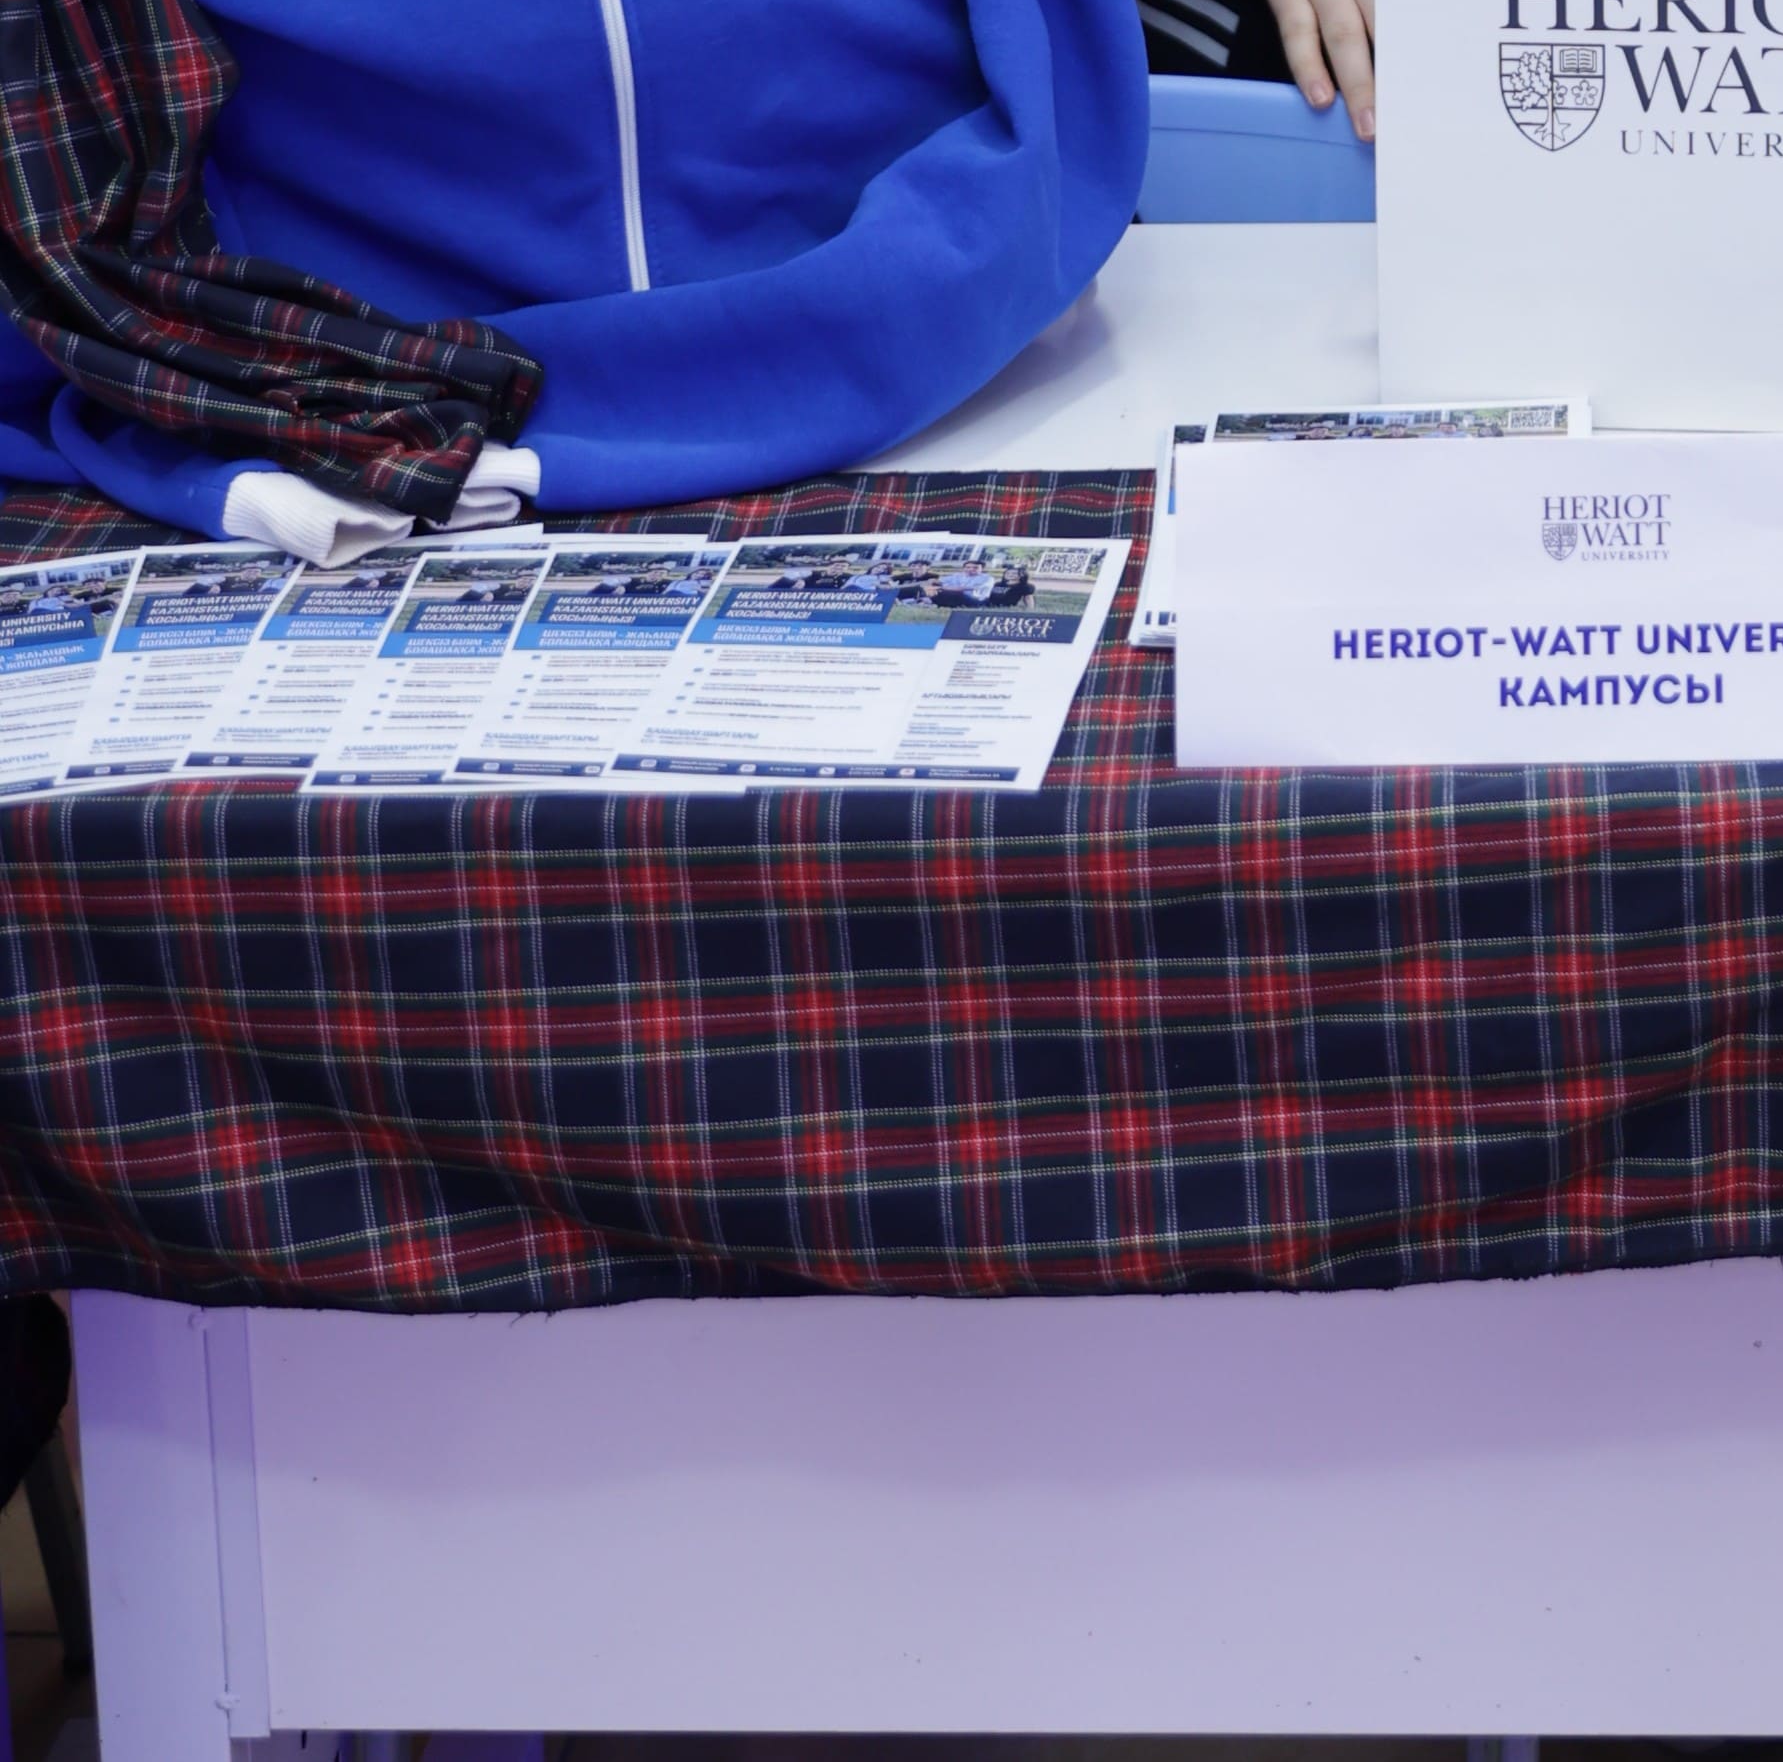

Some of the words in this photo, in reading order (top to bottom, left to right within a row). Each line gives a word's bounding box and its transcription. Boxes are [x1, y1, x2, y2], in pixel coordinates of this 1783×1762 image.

[1541, 494, 1672, 522] HERIOT
[1577, 519, 1672, 548] WATT
[1580, 549, 1672, 563] UNIVERSITY
[1, 611, 71, 628] UNIVERSITY
[973, 615, 1056, 628] HERIOT
[1332, 625, 1622, 662] HERIOT-WATT
[1498, 674, 1726, 708] КАМПУСЫ
